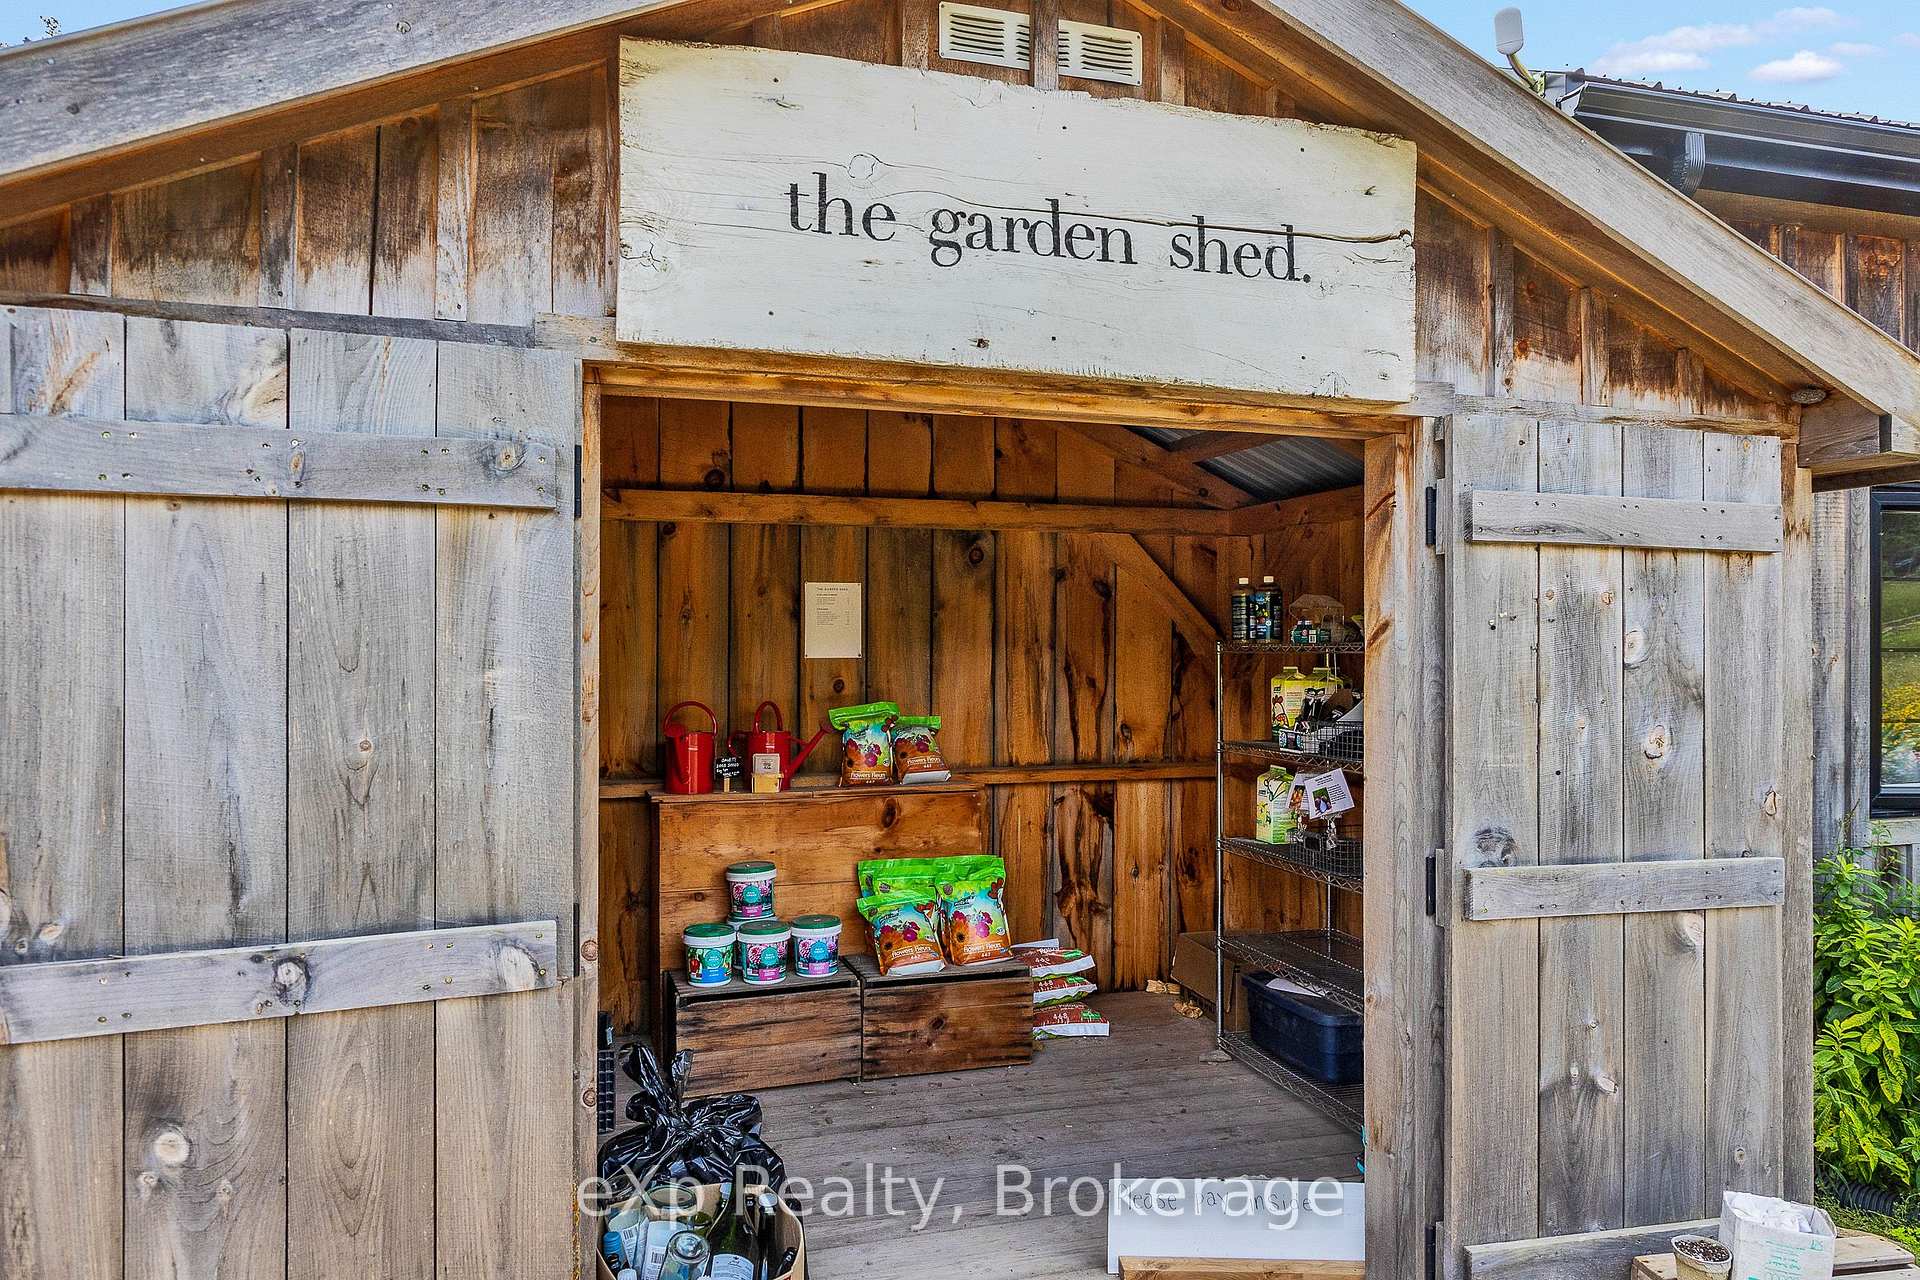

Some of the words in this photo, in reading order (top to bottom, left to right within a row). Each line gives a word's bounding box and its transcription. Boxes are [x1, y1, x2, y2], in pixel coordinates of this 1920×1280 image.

[784, 172, 897, 242] the
[929, 198, 1137, 267] garden
[1169, 215, 1312, 284] shed.
[1117, 1183, 1178, 1211] Please
[1195, 1191, 1230, 1216] pay
